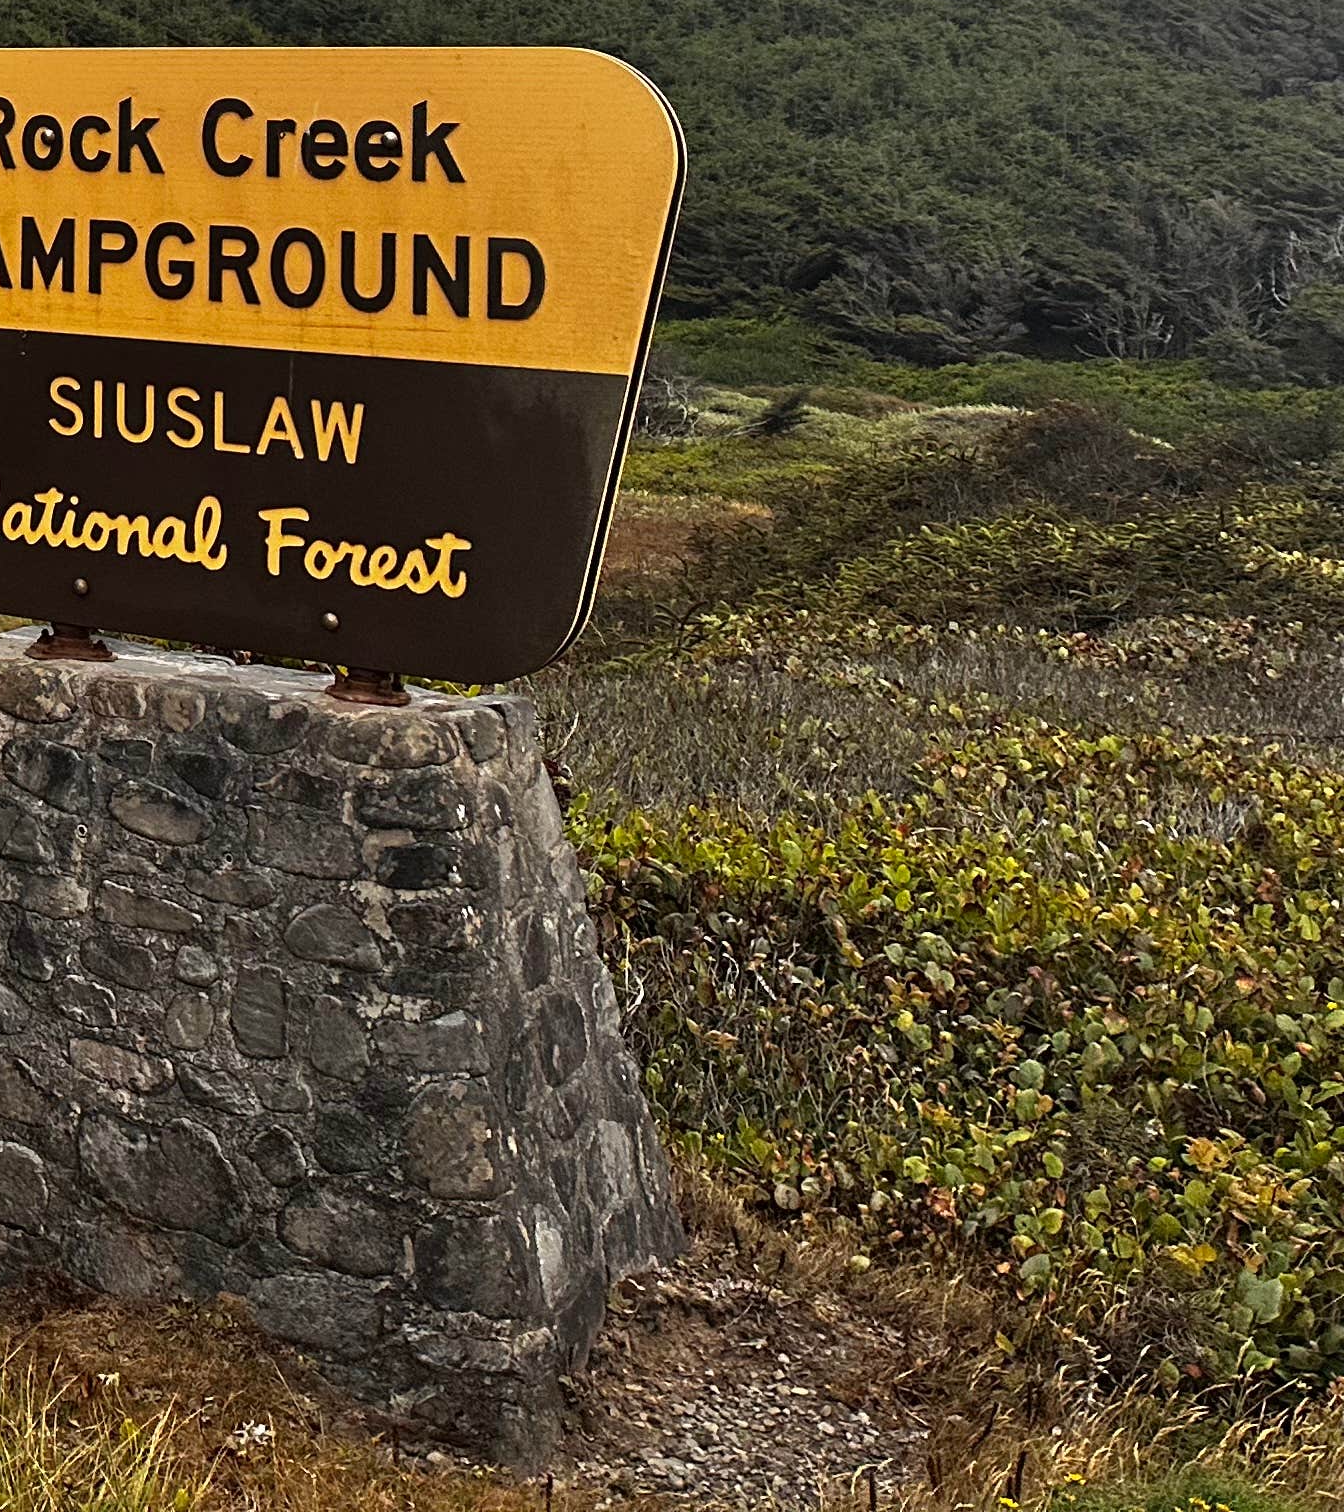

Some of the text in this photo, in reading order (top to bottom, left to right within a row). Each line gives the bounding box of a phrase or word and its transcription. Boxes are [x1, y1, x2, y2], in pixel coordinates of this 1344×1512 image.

[201, 97, 467, 184] Creek
[48, 376, 366, 465] SIUSLAW
[257, 506, 473, 599] Forest
